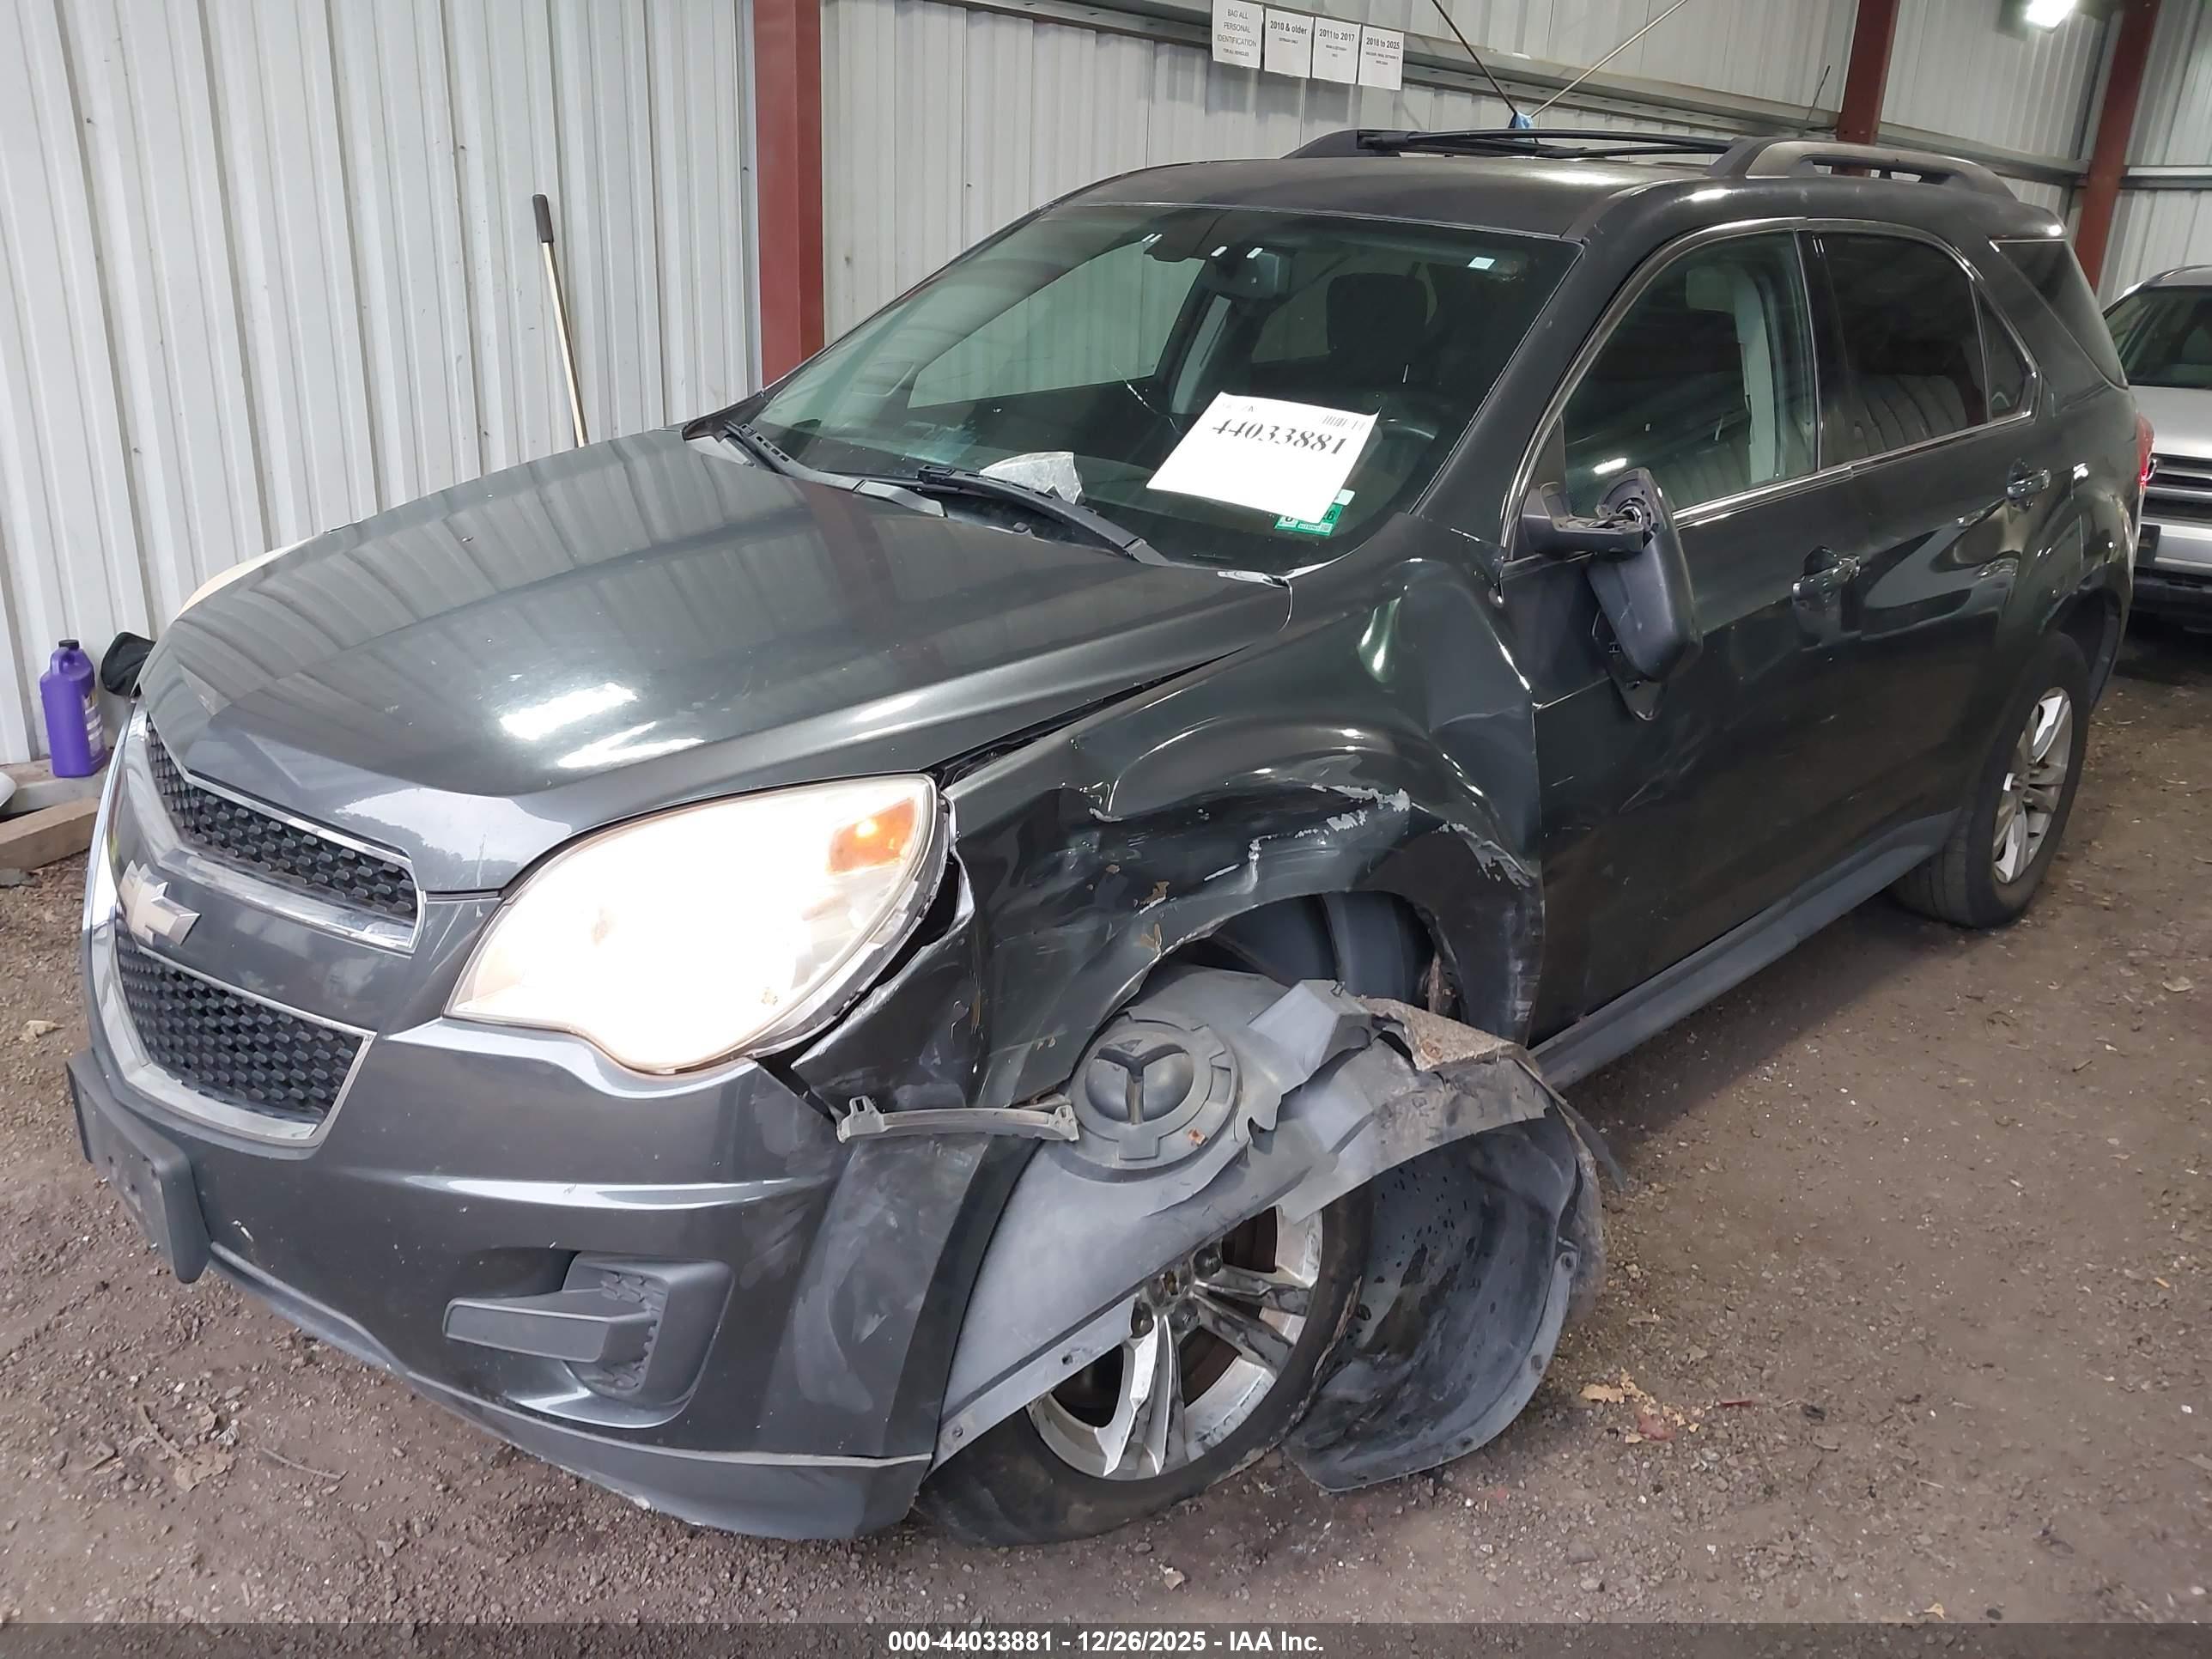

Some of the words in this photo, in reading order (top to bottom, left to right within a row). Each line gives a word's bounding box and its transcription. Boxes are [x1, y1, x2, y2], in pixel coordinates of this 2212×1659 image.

[1227, 9, 1237, 17] BAG
[1224, 22, 1250, 33] PERSONAL
[1270, 21, 1284, 30] 2010
[1291, 24, 1307, 34] older
[1217, 34, 1257, 47] IDENTIFICATION
[1319, 28, 1332, 39] 2011
[1340, 32, 1354, 41] 2017
[1366, 37, 1380, 46] 2018
[1387, 40, 1400, 49] 2025
[1212, 418, 1347, 455] 44033881
